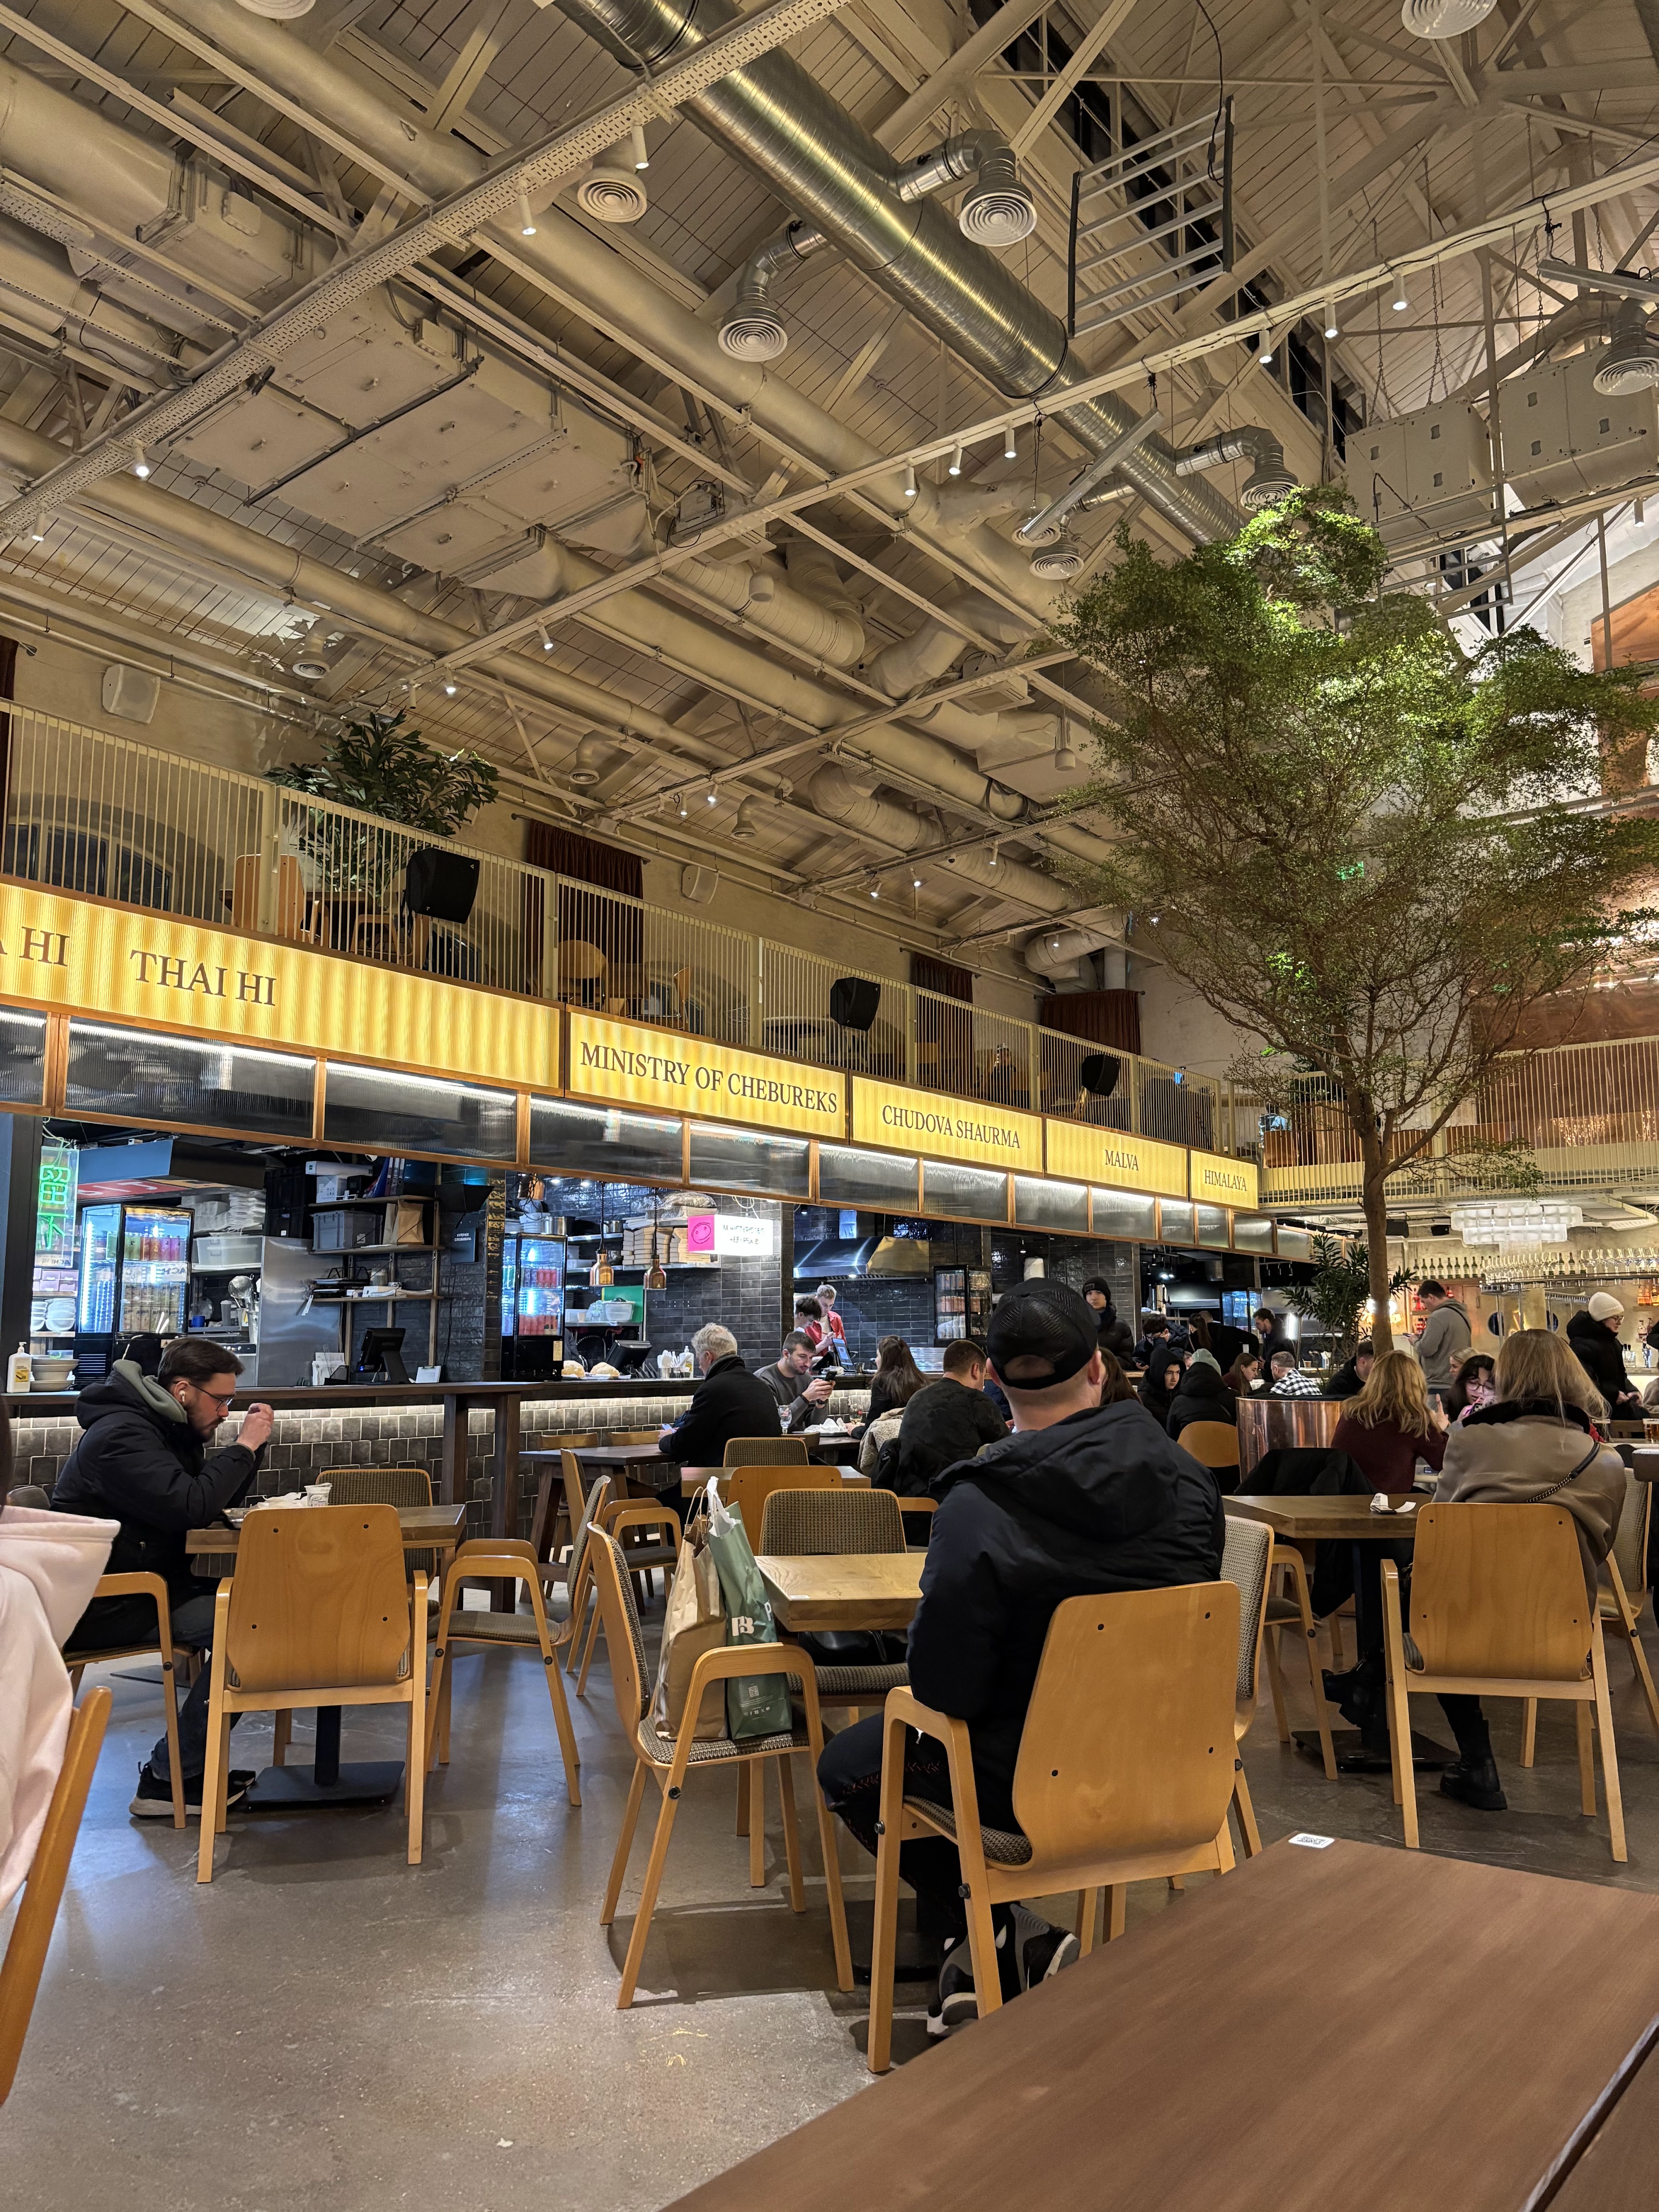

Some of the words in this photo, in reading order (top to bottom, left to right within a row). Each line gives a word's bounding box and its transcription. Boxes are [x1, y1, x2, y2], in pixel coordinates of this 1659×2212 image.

[129, 950, 228, 997] THAI
[235, 971, 276, 1006] HI
[580, 1042, 690, 1085] MINISTRY
[695, 1067, 723, 1091] OF
[728, 1073, 837, 1113] CHEBUREKS
[882, 1105, 953, 1136] CHUDOVA
[957, 1120, 1021, 1149] SHAURMA
[1105, 1149, 1139, 1171] MALVA
[1204, 1169, 1247, 1192] HIMALAYA
